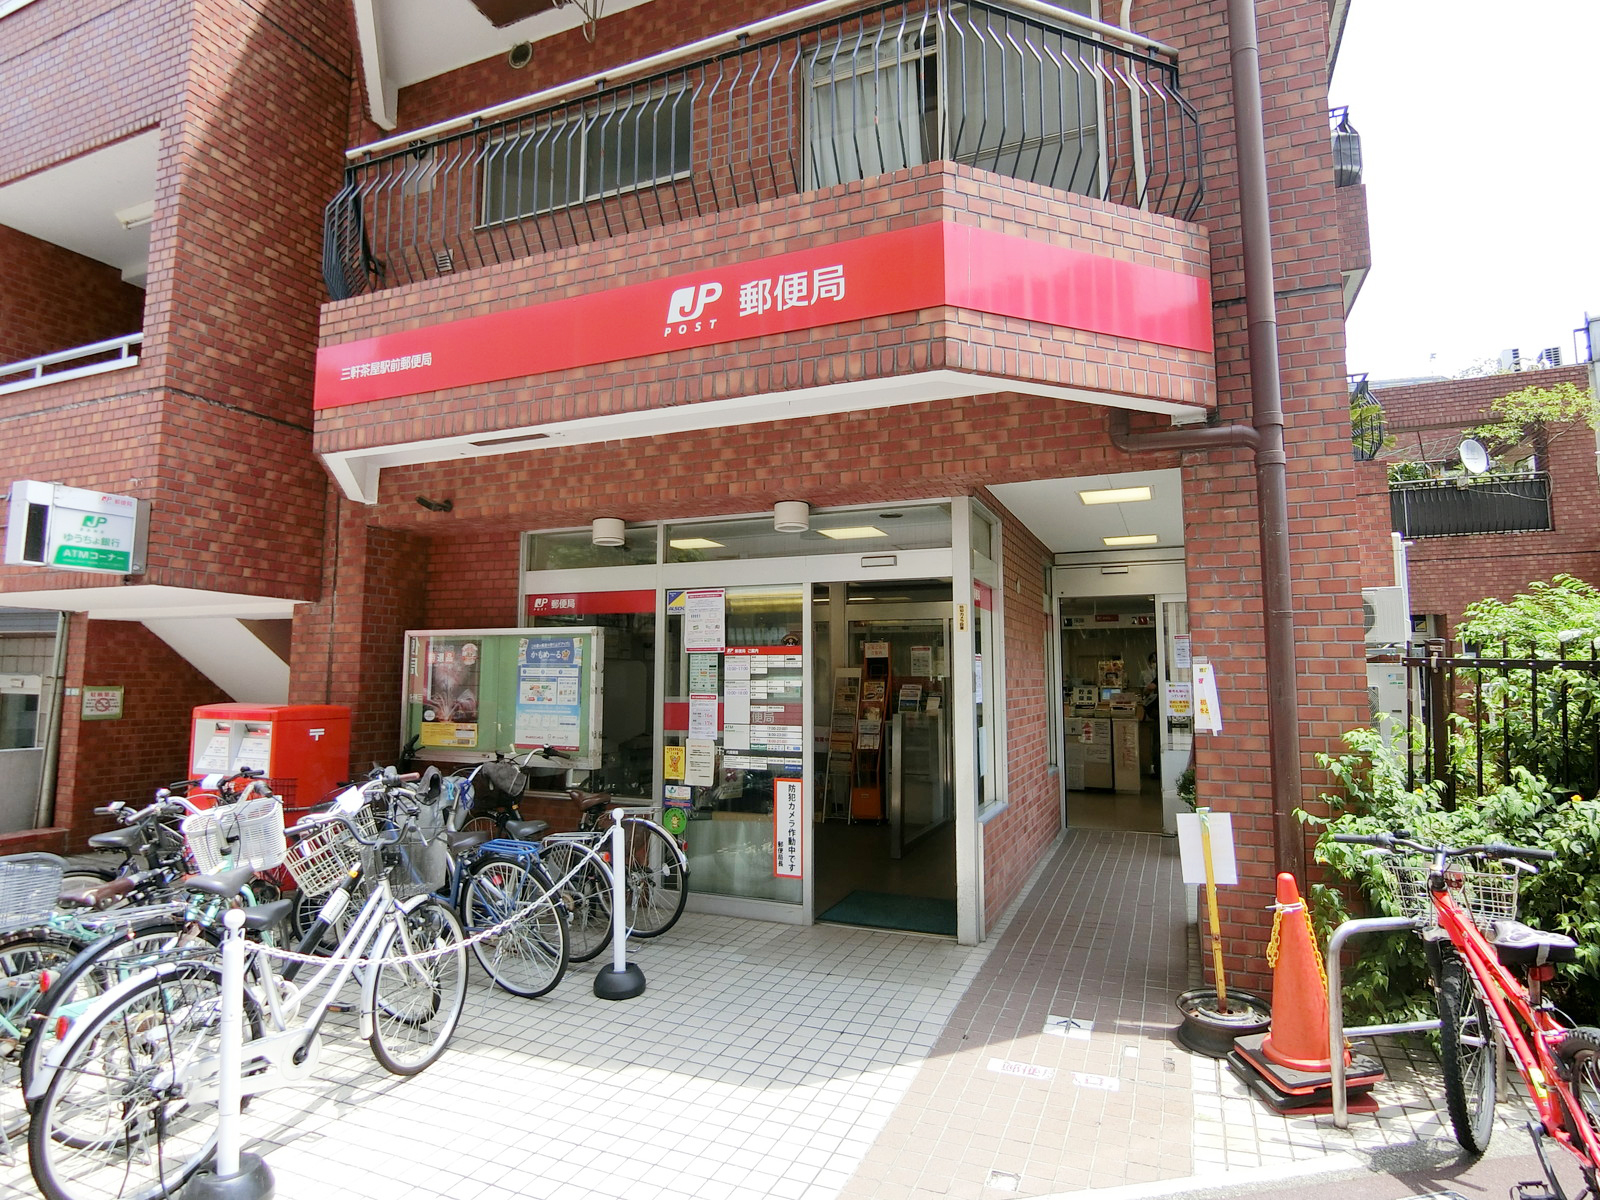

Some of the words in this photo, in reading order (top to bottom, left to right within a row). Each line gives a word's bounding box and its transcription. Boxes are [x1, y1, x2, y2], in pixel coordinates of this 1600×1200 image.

[739, 264, 846, 317] 郵便局
[664, 319, 718, 337] POST
[340, 352, 432, 380] 三軒茶屋駅前郵便局
[63, 533, 120, 548] ゆうちょ銀行
[63, 549, 125, 561] ATMコーナー
[551, 599, 576, 609] 郵便局
[788, 784, 796, 872] 防犯カメラ作動中です
